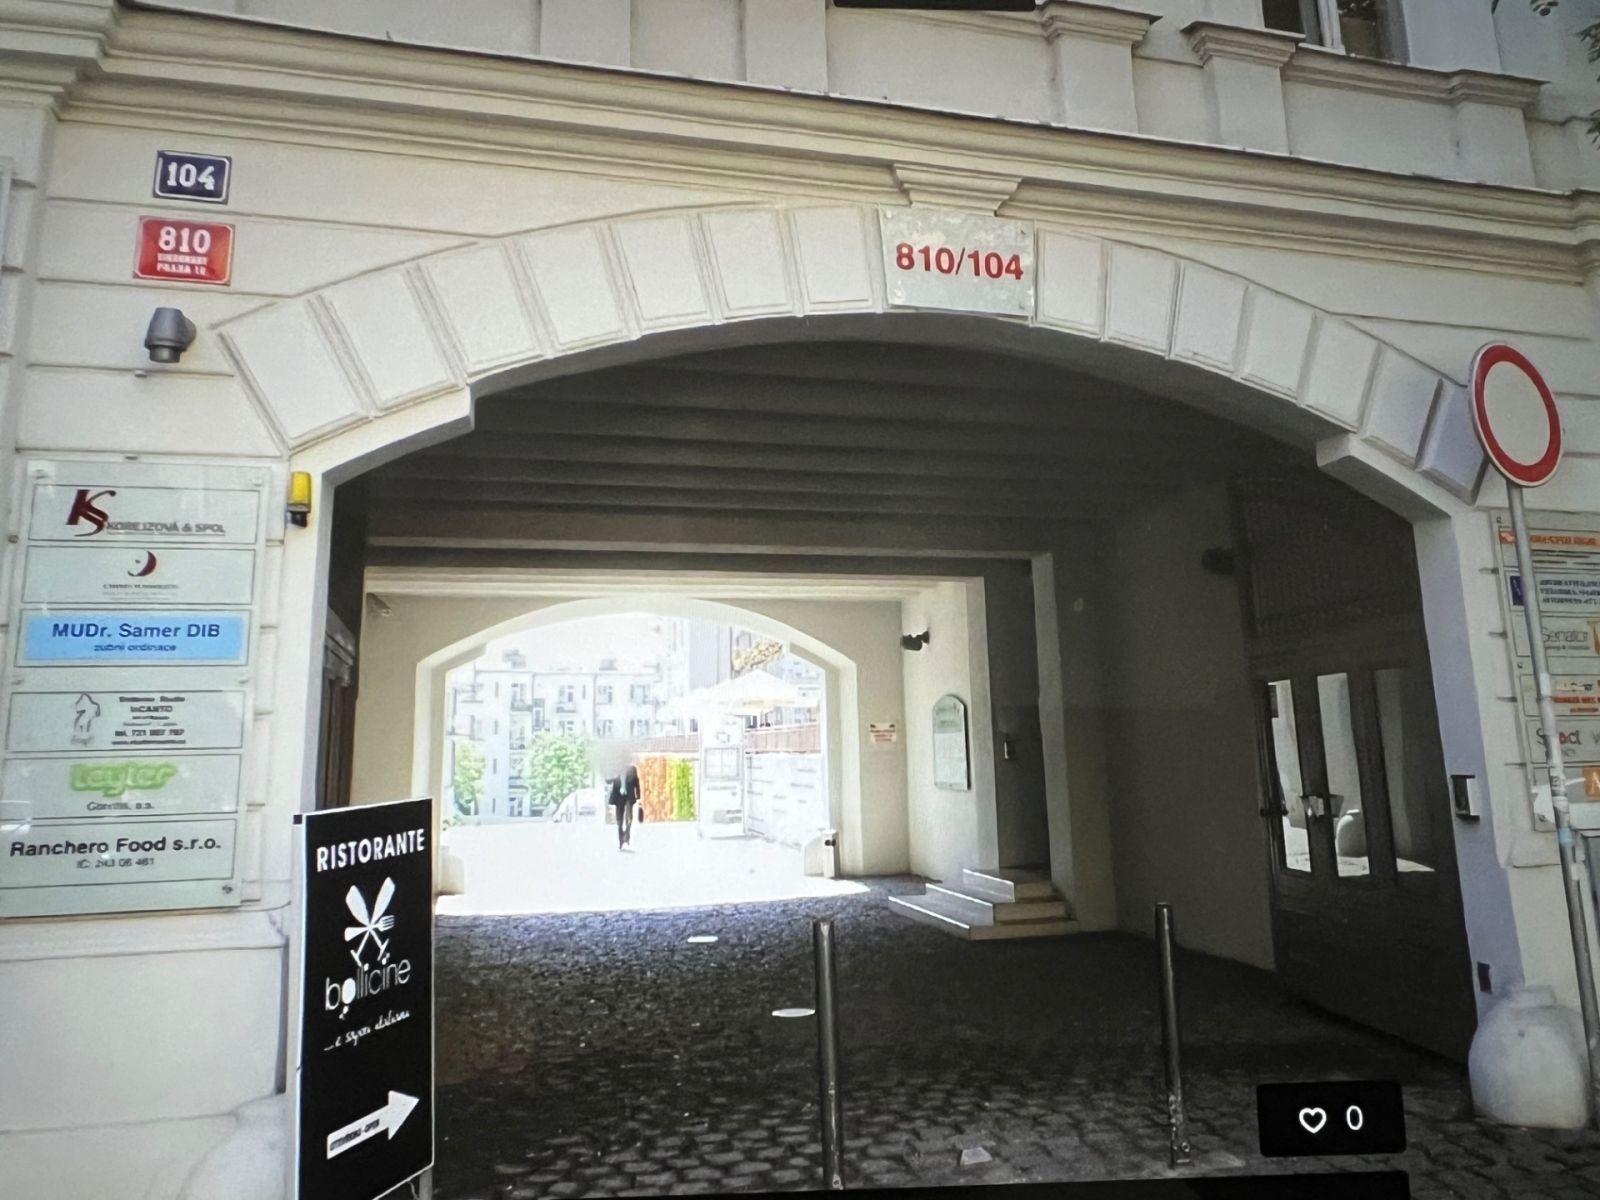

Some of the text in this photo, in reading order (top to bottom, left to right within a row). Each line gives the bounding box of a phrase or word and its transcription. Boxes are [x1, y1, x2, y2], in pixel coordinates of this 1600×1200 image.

[167, 162, 216, 190] 104
[158, 226, 211, 254] 810
[896, 242, 1024, 280] 810/104
[181, 522, 192, 532] &
[52, 623, 221, 638] MUDr. Samer DIB
[10, 836, 221, 857] Ranchero Food s.r.o.
[316, 828, 425, 872] RISTORANTE
